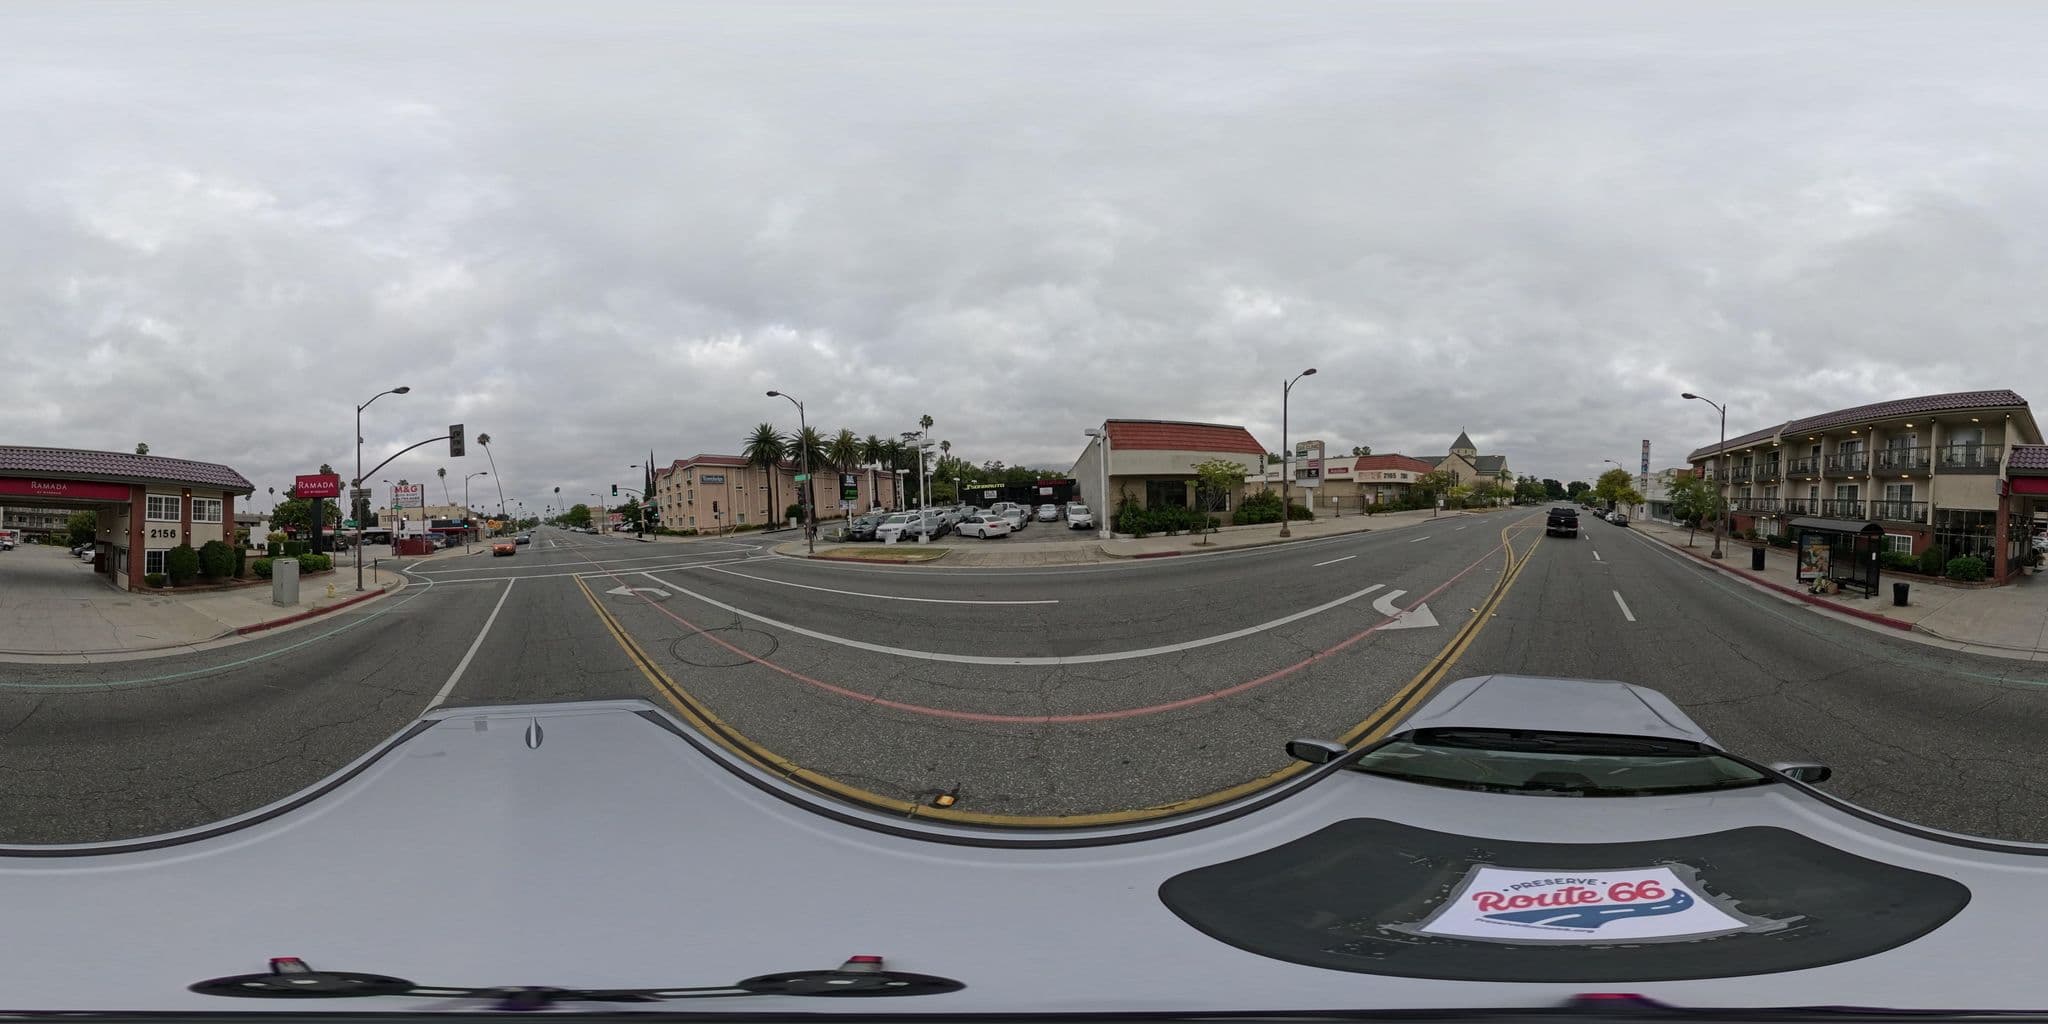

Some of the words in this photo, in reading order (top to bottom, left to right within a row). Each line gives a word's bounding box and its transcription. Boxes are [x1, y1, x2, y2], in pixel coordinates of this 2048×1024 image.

[31, 481, 68, 490] RAMADA
[298, 481, 335, 489] RAMADA
[394, 485, 418, 493] M&G
[151, 528, 177, 539] 2156
[1509, 877, 1598, 891] PRESERVE
[1472, 886, 1604, 913] Route
[1608, 880, 1666, 903] 66
